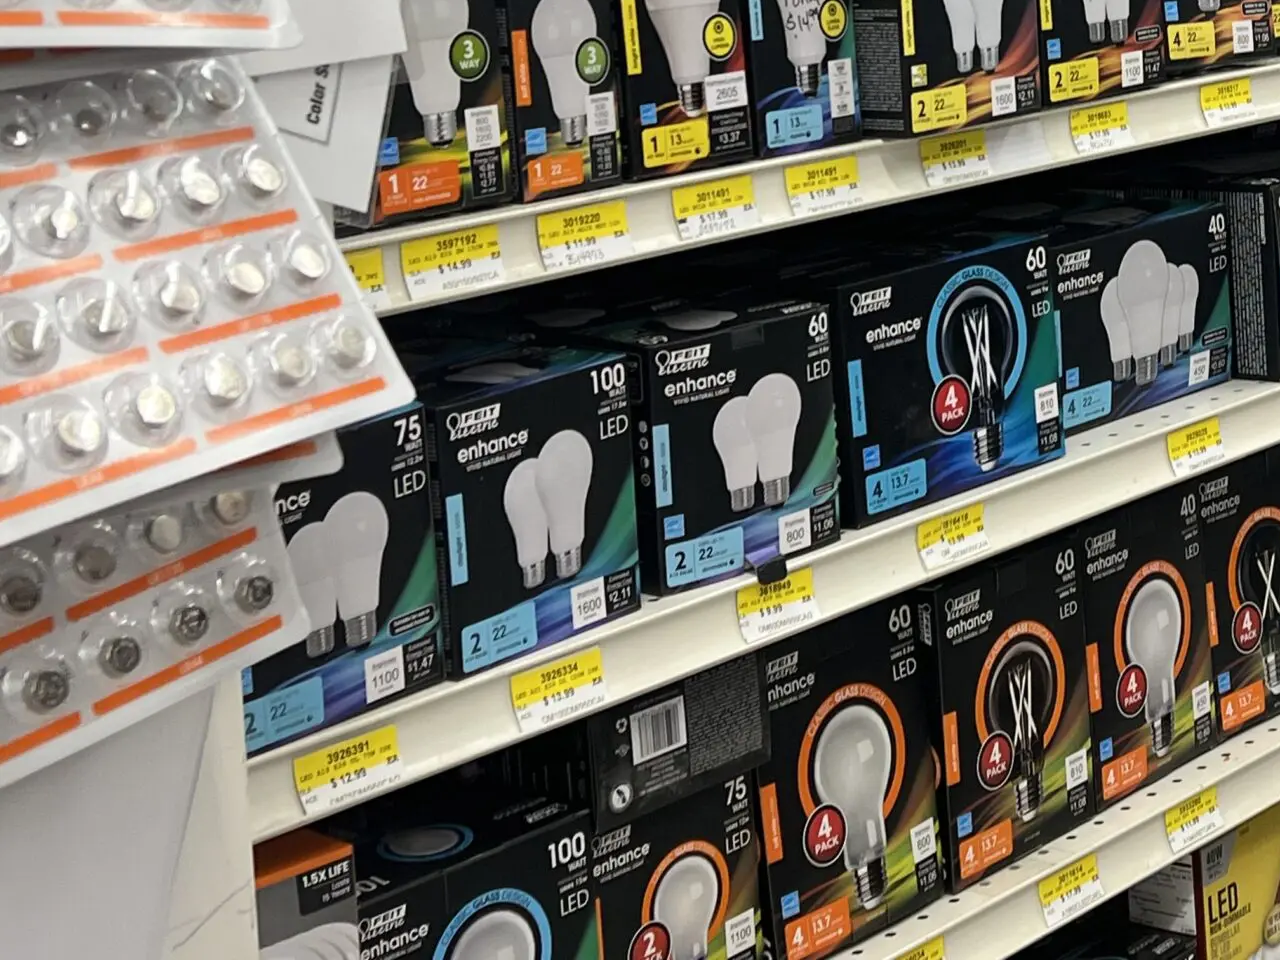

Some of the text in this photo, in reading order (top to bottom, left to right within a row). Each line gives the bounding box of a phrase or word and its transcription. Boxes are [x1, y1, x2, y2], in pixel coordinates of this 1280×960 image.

[460, 57, 481, 71] WAY
[583, 63, 602, 76] WAY
[307, 83, 326, 126] Color
[807, 167, 837, 180] 3011491
[696, 187, 730, 202] 3011491
[563, 212, 601, 228] 3019220
[1025, 246, 1047, 272] 60
[1209, 255, 1228, 273] LED
[1057, 271, 1104, 294] enhance
[1032, 300, 1051, 318] LED
[808, 312, 828, 337] 60
[866, 318, 922, 344] enhance
[671, 344, 711, 365] FEIT
[590, 363, 625, 395] 100
[806, 359, 831, 382] LED
[664, 369, 738, 397] enhance
[460, 403, 501, 425] FEIT
[942, 406, 964, 422] PACK
[394, 415, 422, 445] 75
[600, 415, 628, 440] LED
[458, 429, 529, 464] enhance
[394, 470, 426, 499] LED
[1180, 494, 1196, 518] 40
[1201, 494, 1240, 518] enhance
[1055, 548, 1075, 575] 60
[1087, 549, 1129, 575] enhance
[1185, 542, 1200, 560] LED
[608, 586, 631, 605] $2.11
[888, 603, 912, 634] 60
[1059, 600, 1078, 621] LED
[946, 609, 993, 640] enhance
[408, 654, 434, 674] $1.47
[540, 662, 579, 683] 3926334
[892, 657, 917, 682] LED
[327, 740, 370, 765] 3926391
[340, 767, 368, 785] 12.99
[986, 760, 1007, 779] PACK
[724, 776, 747, 807] 75
[547, 832, 586, 869] 100
[725, 828, 750, 855] LED
[814, 834, 840, 856] PACK
[592, 843, 651, 877] enhance
[302, 860, 350, 888] 1.5X LIFE
[472, 892, 500, 908] GLASS
[559, 888, 590, 917] LED
[1207, 883, 1239, 923] LED
